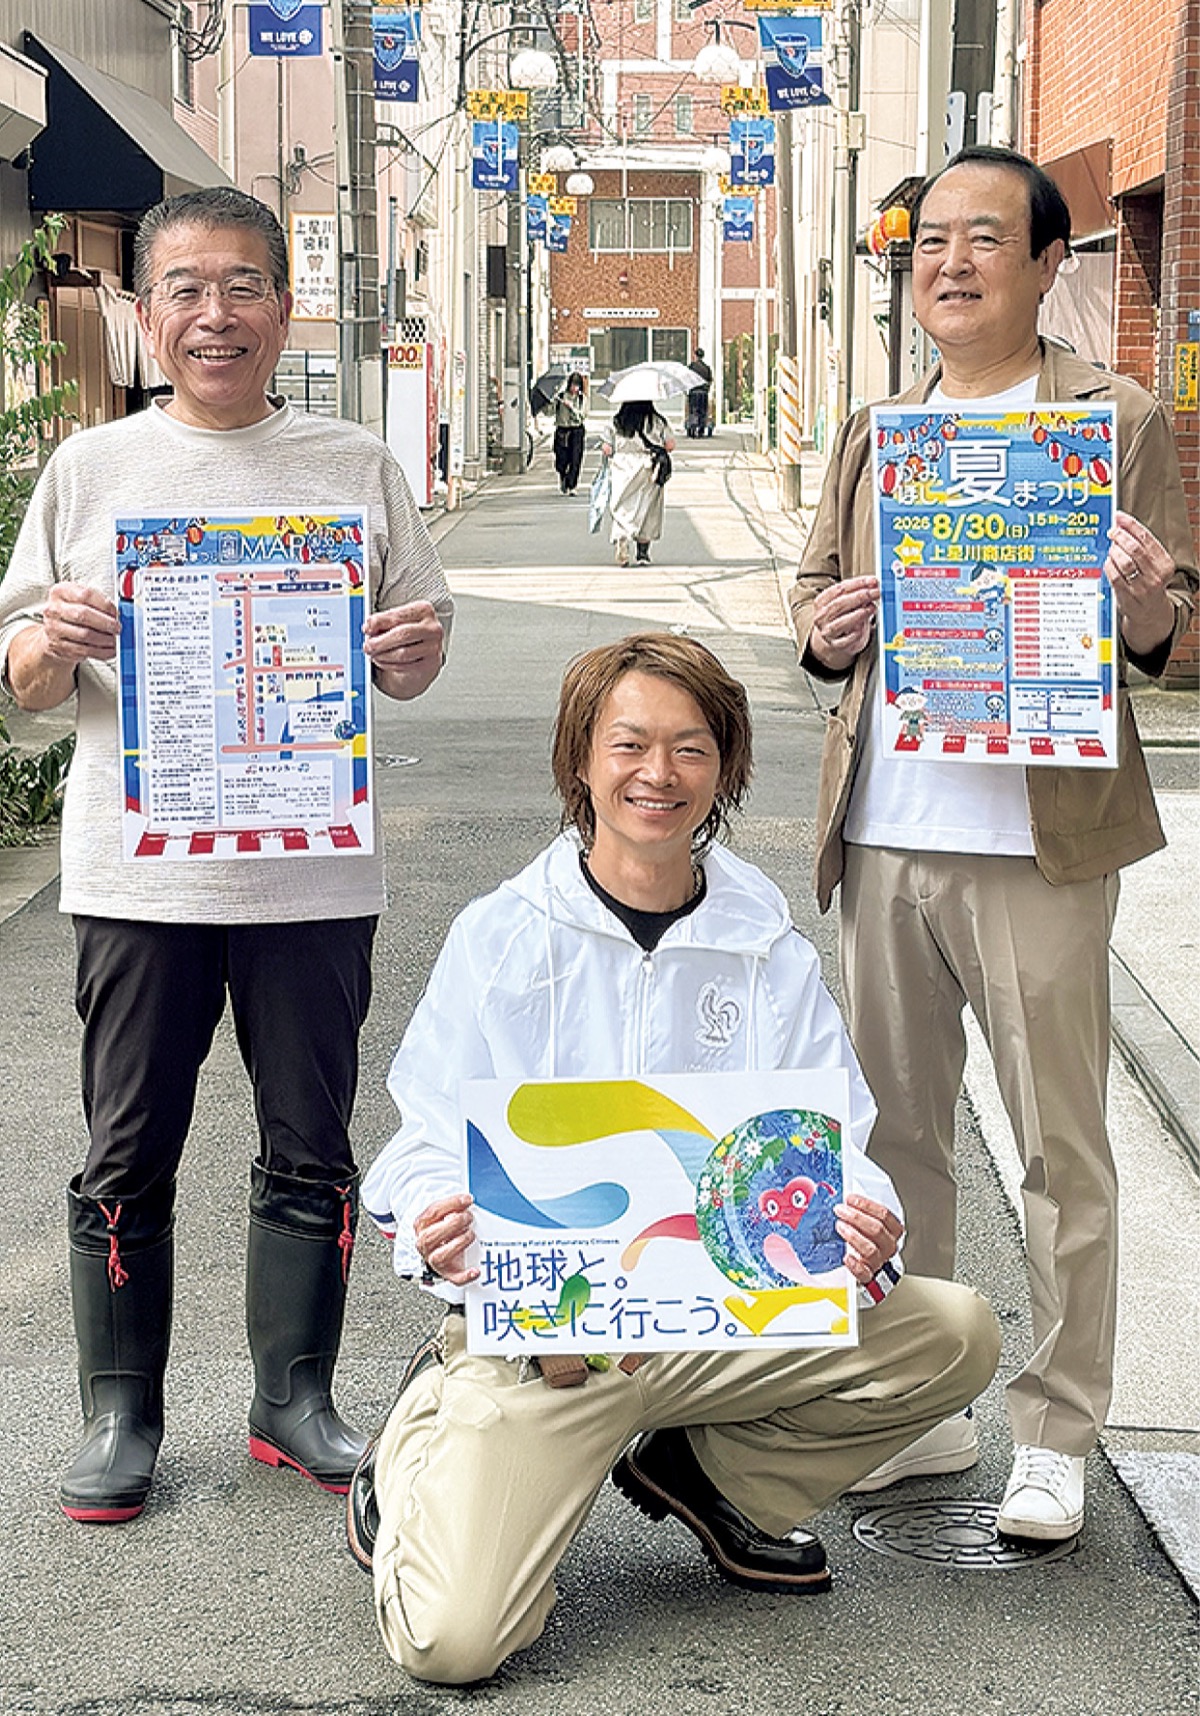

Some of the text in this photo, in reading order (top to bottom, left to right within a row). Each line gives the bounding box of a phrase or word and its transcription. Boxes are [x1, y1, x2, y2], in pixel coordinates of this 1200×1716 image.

[295, 220, 332, 235] 上星川
[388, 345, 418, 363] 100
[480, 1249, 628, 1292] 地球と。
[483, 1294, 739, 1342] 咲きに行こう。
